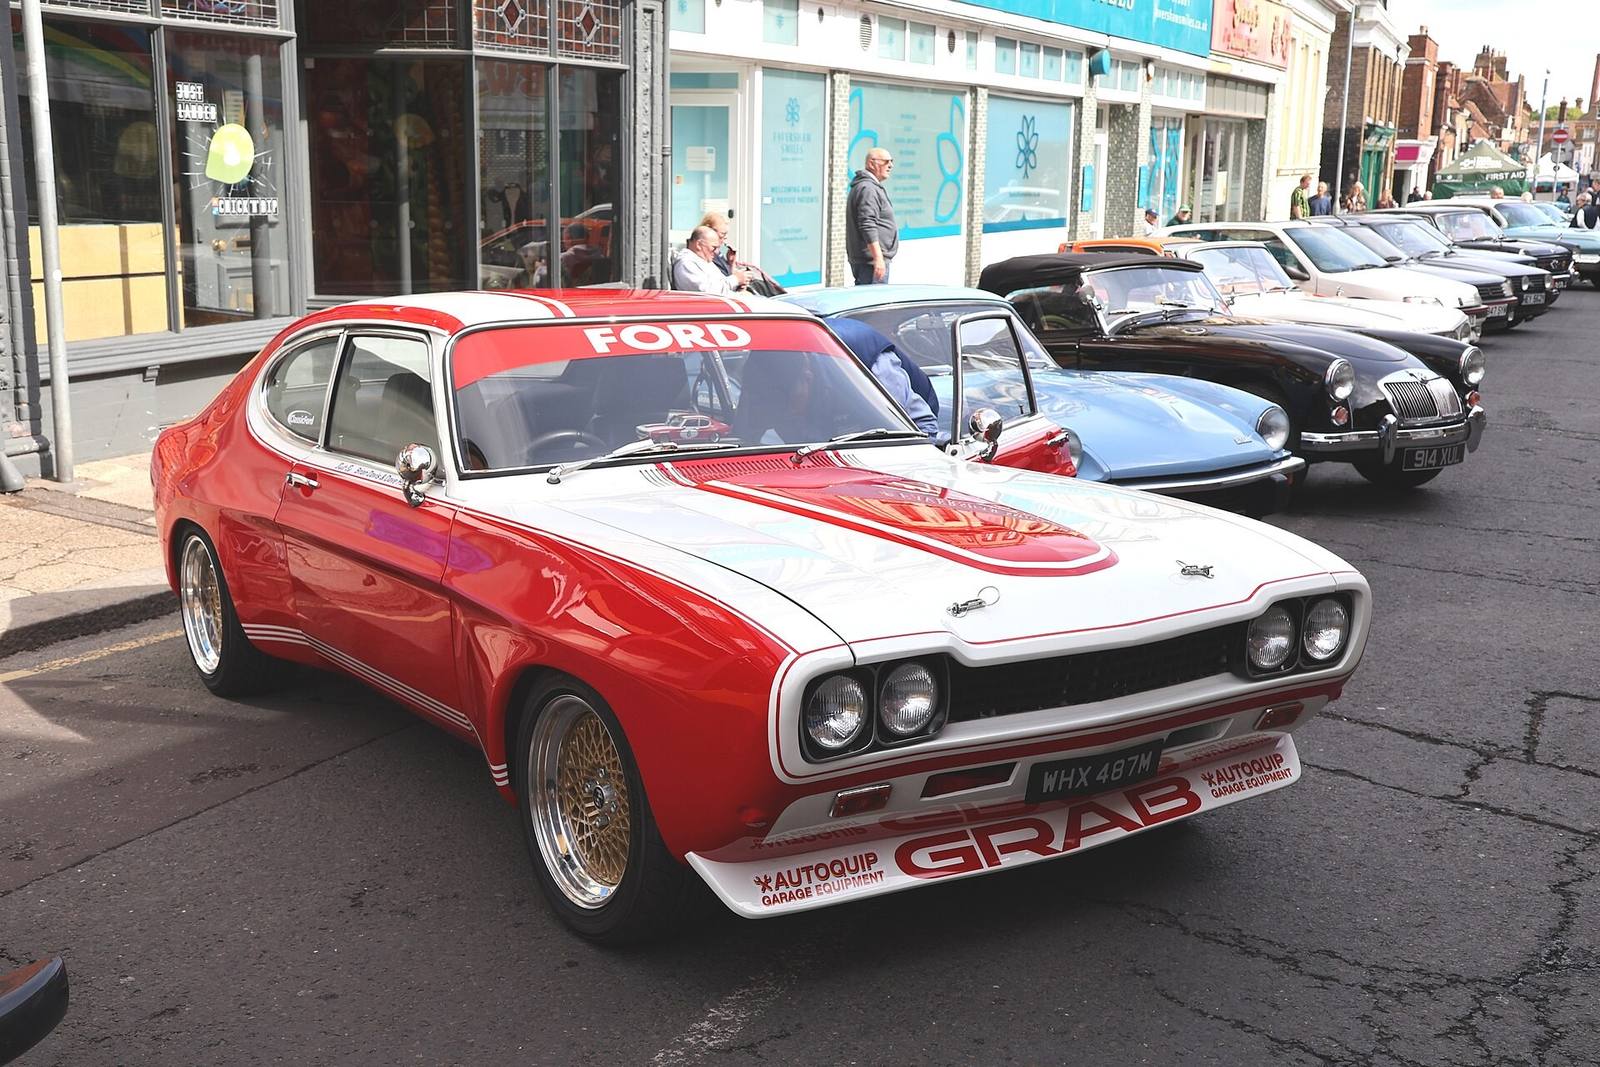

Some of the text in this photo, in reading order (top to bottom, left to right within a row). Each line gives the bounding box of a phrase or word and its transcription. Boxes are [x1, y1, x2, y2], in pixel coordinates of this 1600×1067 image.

[176, 82, 203, 101] JUST
[177, 102, 217, 121] LANDED
[1485, 171, 1526, 181] FIRST AID
[583, 323, 751, 353] FORD
[1414, 446, 1460, 468] 914 XUL
[1042, 751, 1153, 793] WHX 487M
[1211, 768, 1293, 798] GARAGE EQUIPMENT
[1215, 752, 1284, 785] AUTOQUIP
[894, 776, 1203, 880] GRAB
[774, 852, 879, 891] AUTOQUIP
[761, 870, 885, 907] GARAGE EQUIPMENT
